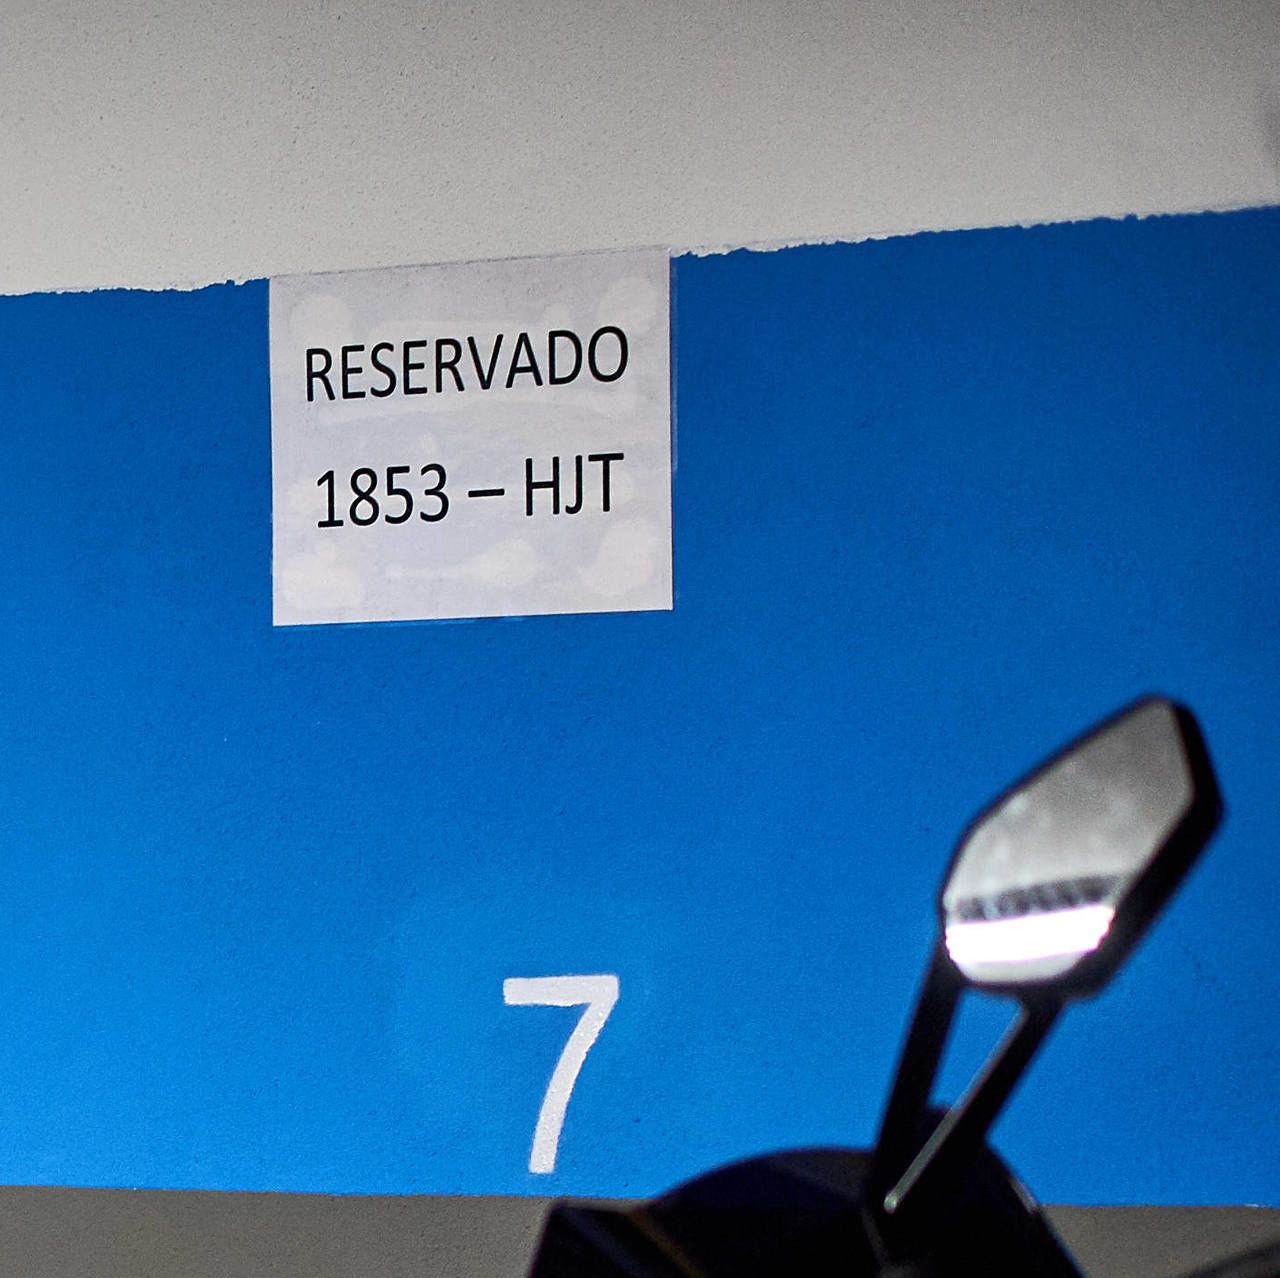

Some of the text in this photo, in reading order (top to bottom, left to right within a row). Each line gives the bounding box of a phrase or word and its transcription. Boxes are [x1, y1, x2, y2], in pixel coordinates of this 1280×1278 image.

[305, 325, 630, 402] RESERVADO
[315, 463, 450, 529] 1853
[524, 452, 625, 517] HJT
[502, 973, 620, 1175] 7
